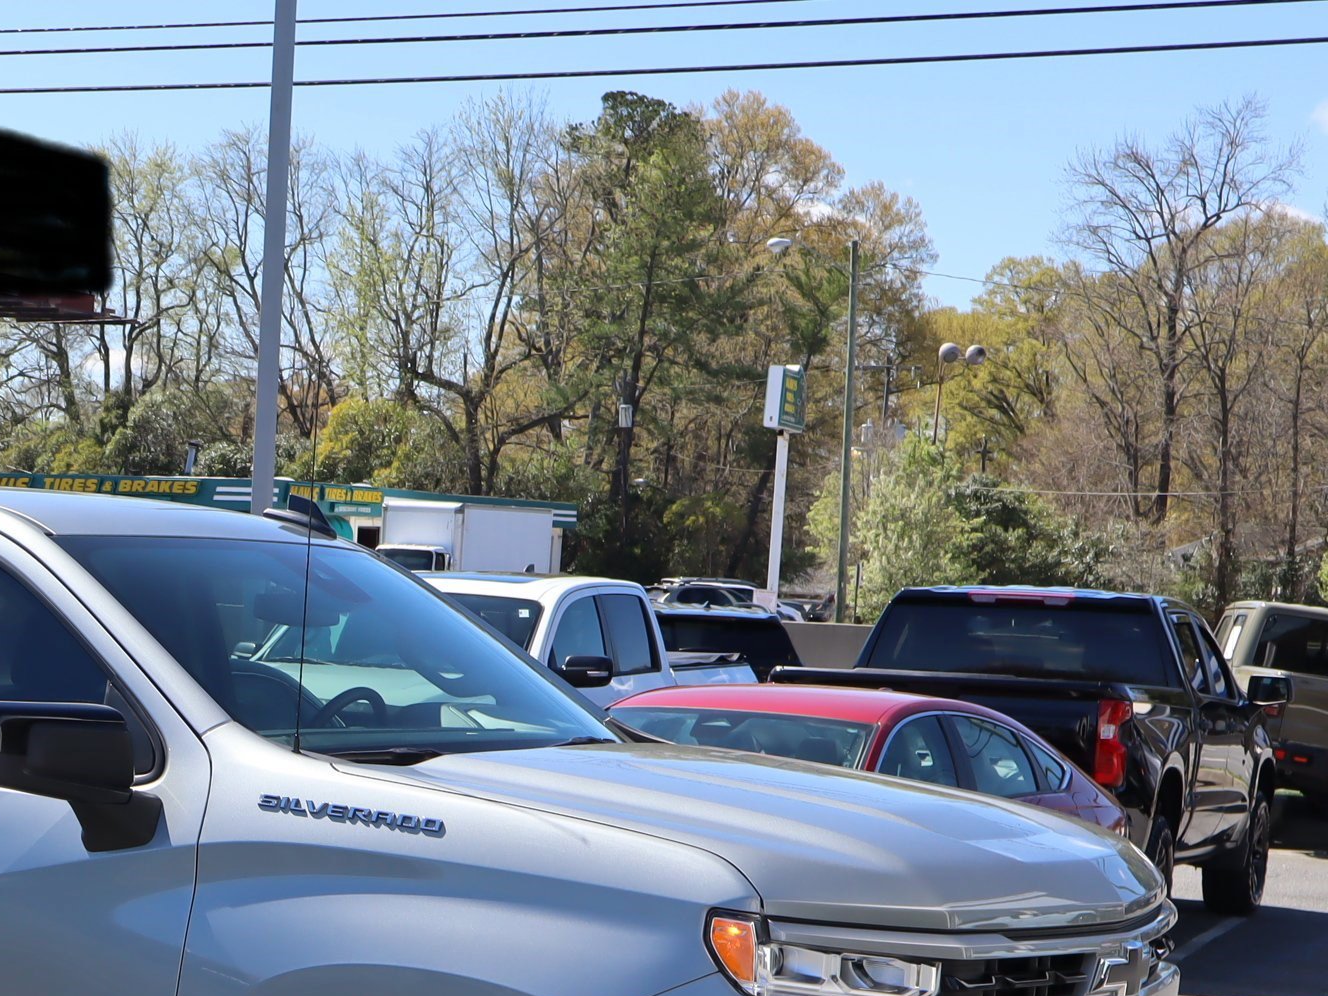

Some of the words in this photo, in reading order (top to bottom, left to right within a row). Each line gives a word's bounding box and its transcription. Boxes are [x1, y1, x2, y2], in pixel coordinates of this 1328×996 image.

[44, 478, 98, 492] TIRES
[102, 481, 113, 491] &
[118, 479, 198, 494] BRAKES
[325, 487, 346, 502] TIRES
[352, 489, 383, 504] BRAKES
[257, 793, 446, 836] SILVERADO
